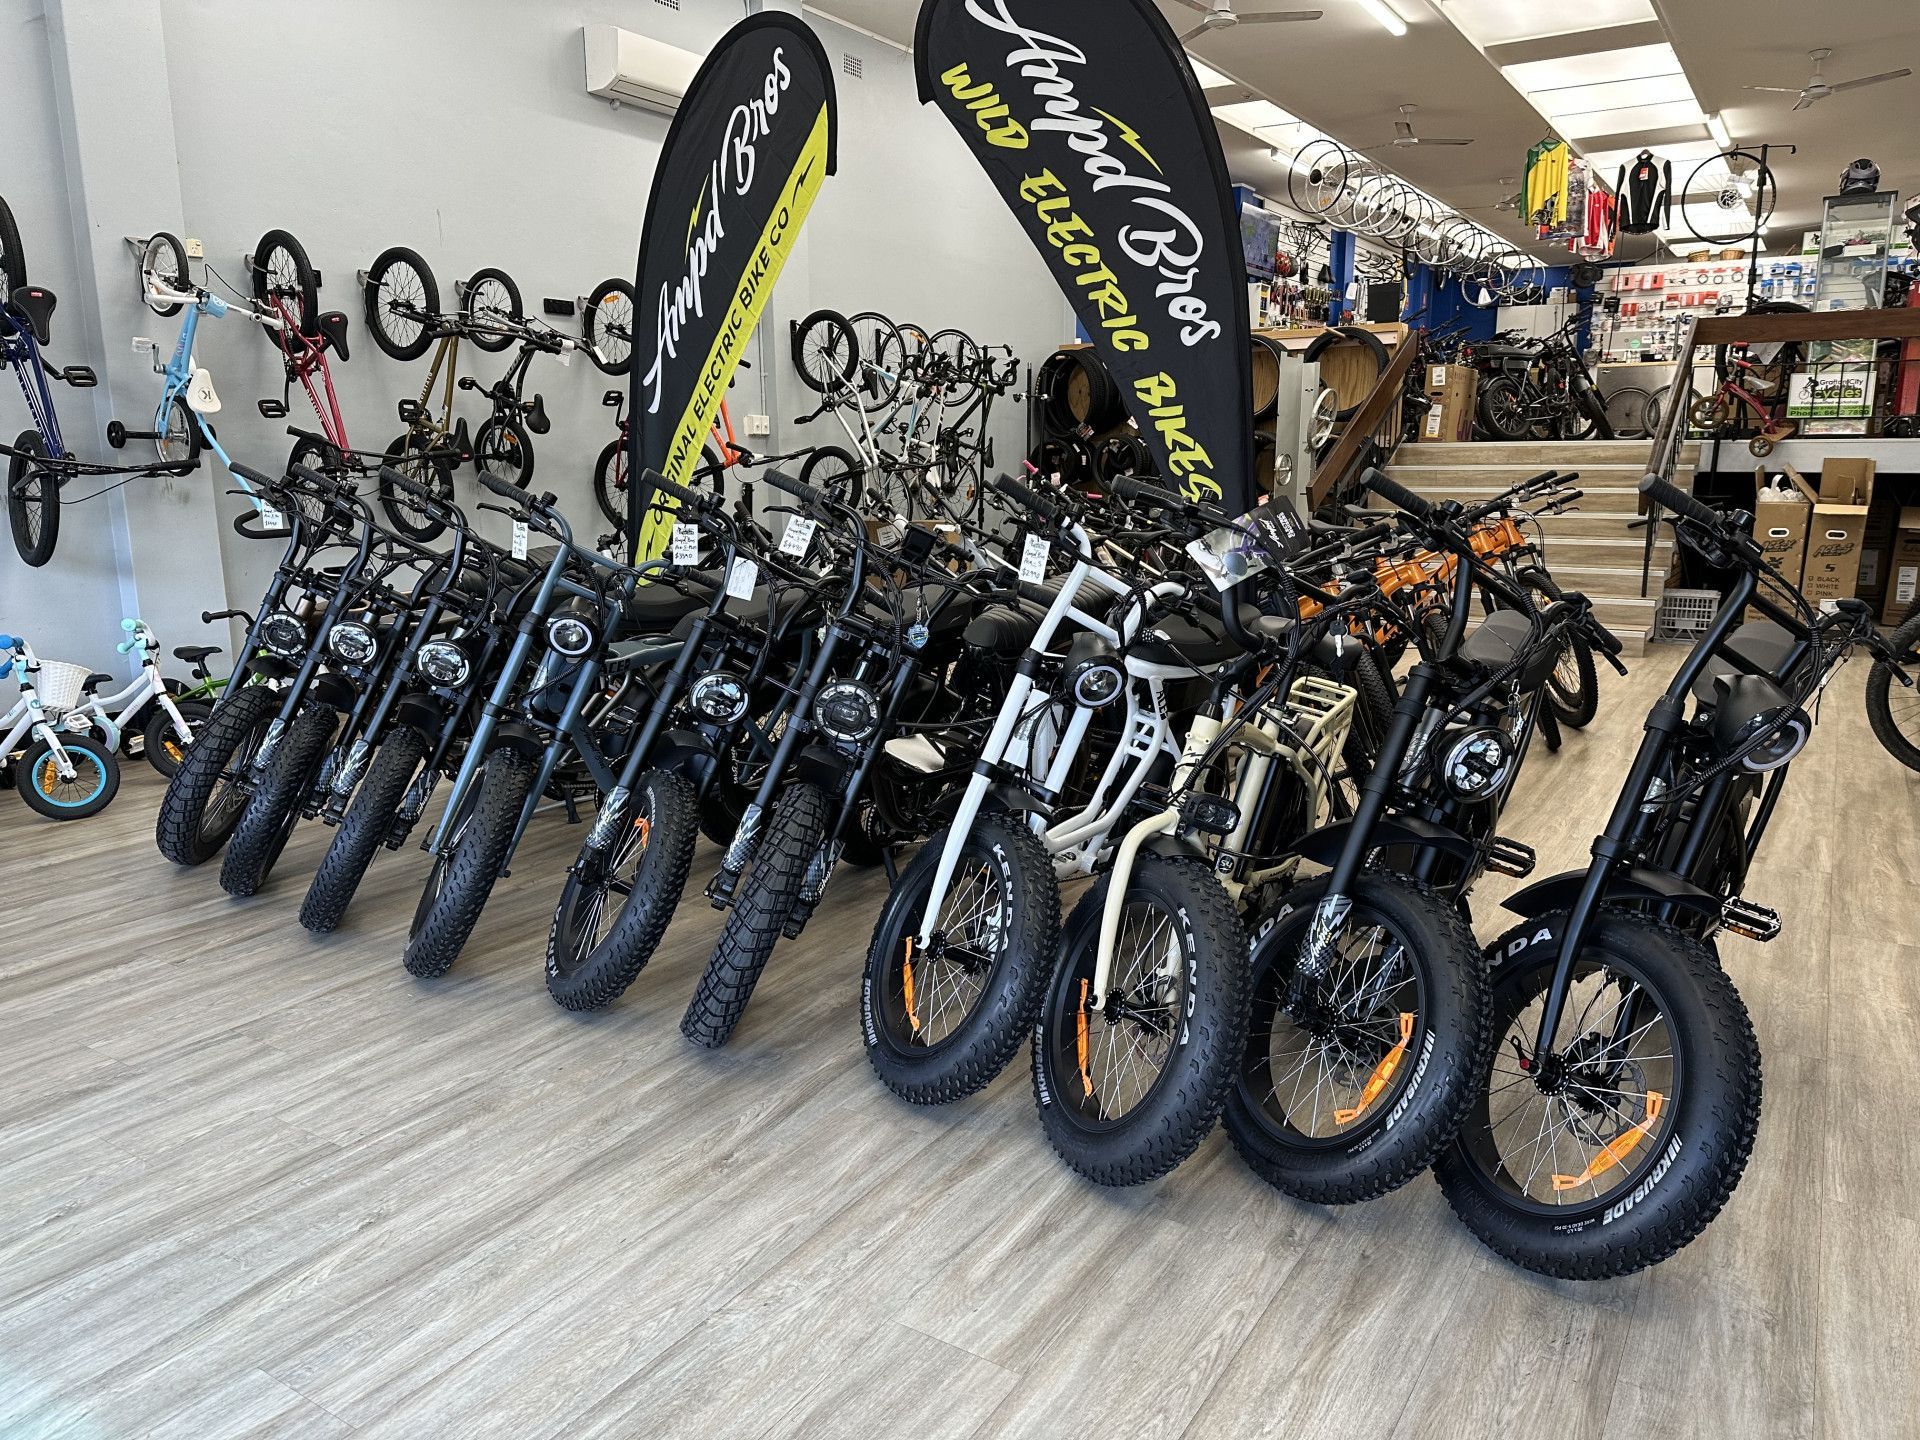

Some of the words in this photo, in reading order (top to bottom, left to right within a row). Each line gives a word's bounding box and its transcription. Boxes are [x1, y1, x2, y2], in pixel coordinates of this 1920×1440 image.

[940, 62, 1029, 149] WILD
[1019, 167, 1149, 352] ELECTRIC
[964, 0, 1171, 193] Ampd
[1118, 196, 1221, 347] Bros
[643, 160, 724, 413] Ampd
[720, 46, 791, 196] Bros
[654, 424, 697, 525] ORGINAL
[693, 308, 743, 422] ELECTRIC
[739, 249, 770, 311] BIKE
[769, 206, 789, 246] CO
[1814, 388, 1862, 401] cycles
[992, 843, 1012, 952] KENDA
[1486, 928, 1552, 974] NDA
[1178, 906, 1196, 1046] KENDA
[1034, 1024, 1046, 1089] KRUSADE
[1385, 1047, 1431, 1131] KRUSADE
[1602, 1151, 1672, 1226] KRUSADE
